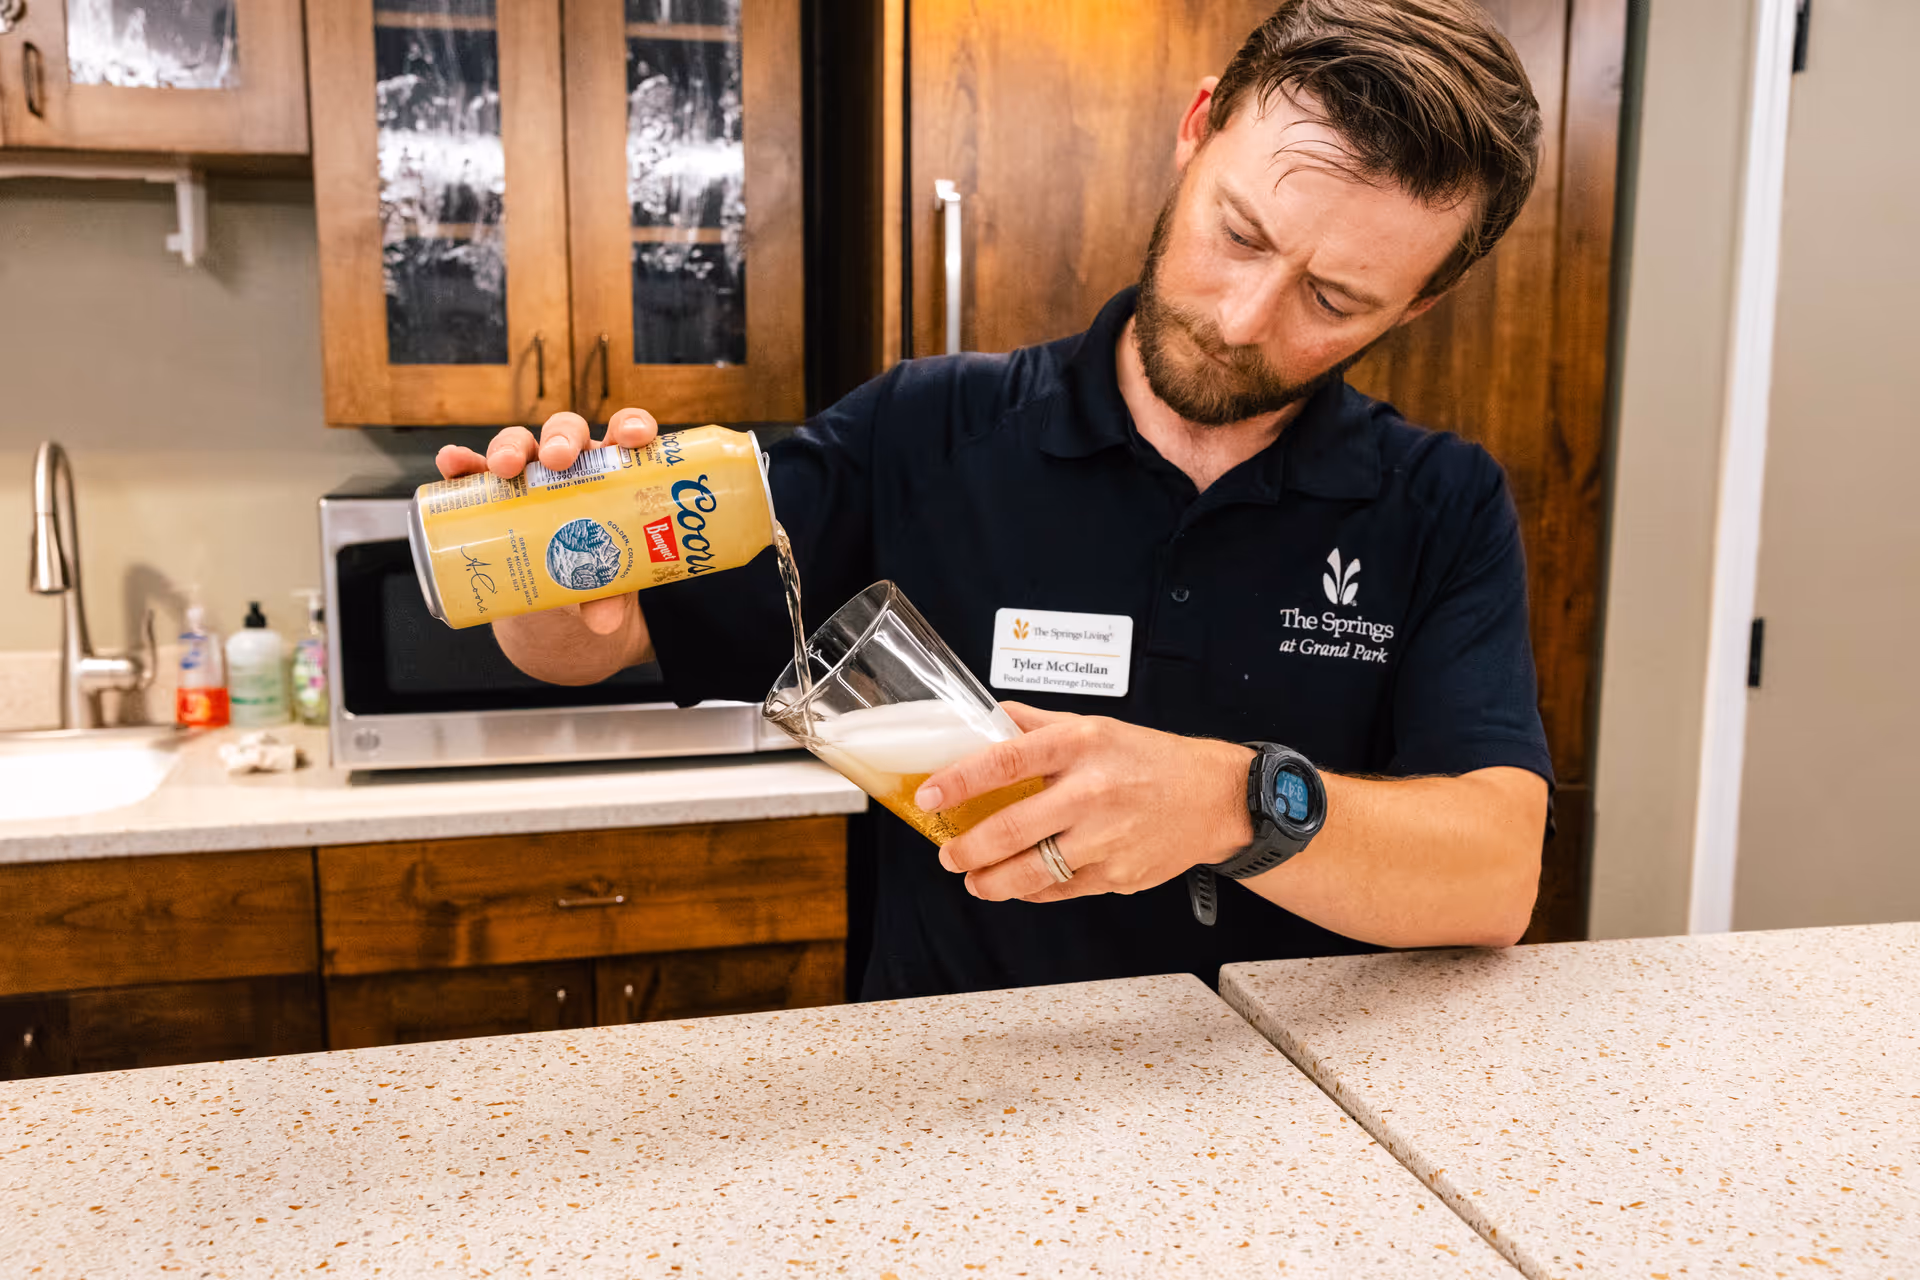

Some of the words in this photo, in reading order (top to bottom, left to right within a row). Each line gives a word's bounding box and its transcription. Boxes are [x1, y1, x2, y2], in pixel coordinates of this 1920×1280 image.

[646, 522, 677, 561] Banquet
[506, 557, 516, 577] SINCE
[508, 529, 519, 553] ROCKY
[515, 556, 528, 589] MOUNTAIN
[519, 537, 531, 568] BREWED
[527, 569, 535, 585] WITH
[620, 547, 633, 579] COLORADO
[1034, 627, 1049, 637] The
[1051, 628, 1083, 640] Springs
[1280, 608, 1318, 630] The
[1321, 611, 1394, 643] Springs
[1279, 638, 1297, 653] at
[1299, 638, 1351, 658] Grand
[1352, 643, 1388, 664] Park
[1003, 673, 1024, 683] Food
[1026, 676, 1041, 684] and
[1043, 677, 1080, 688] Beverage
[1081, 679, 1115, 689] Director
[1012, 658, 1043, 672] Tyler
[1046, 660, 1109, 675] McClellan
